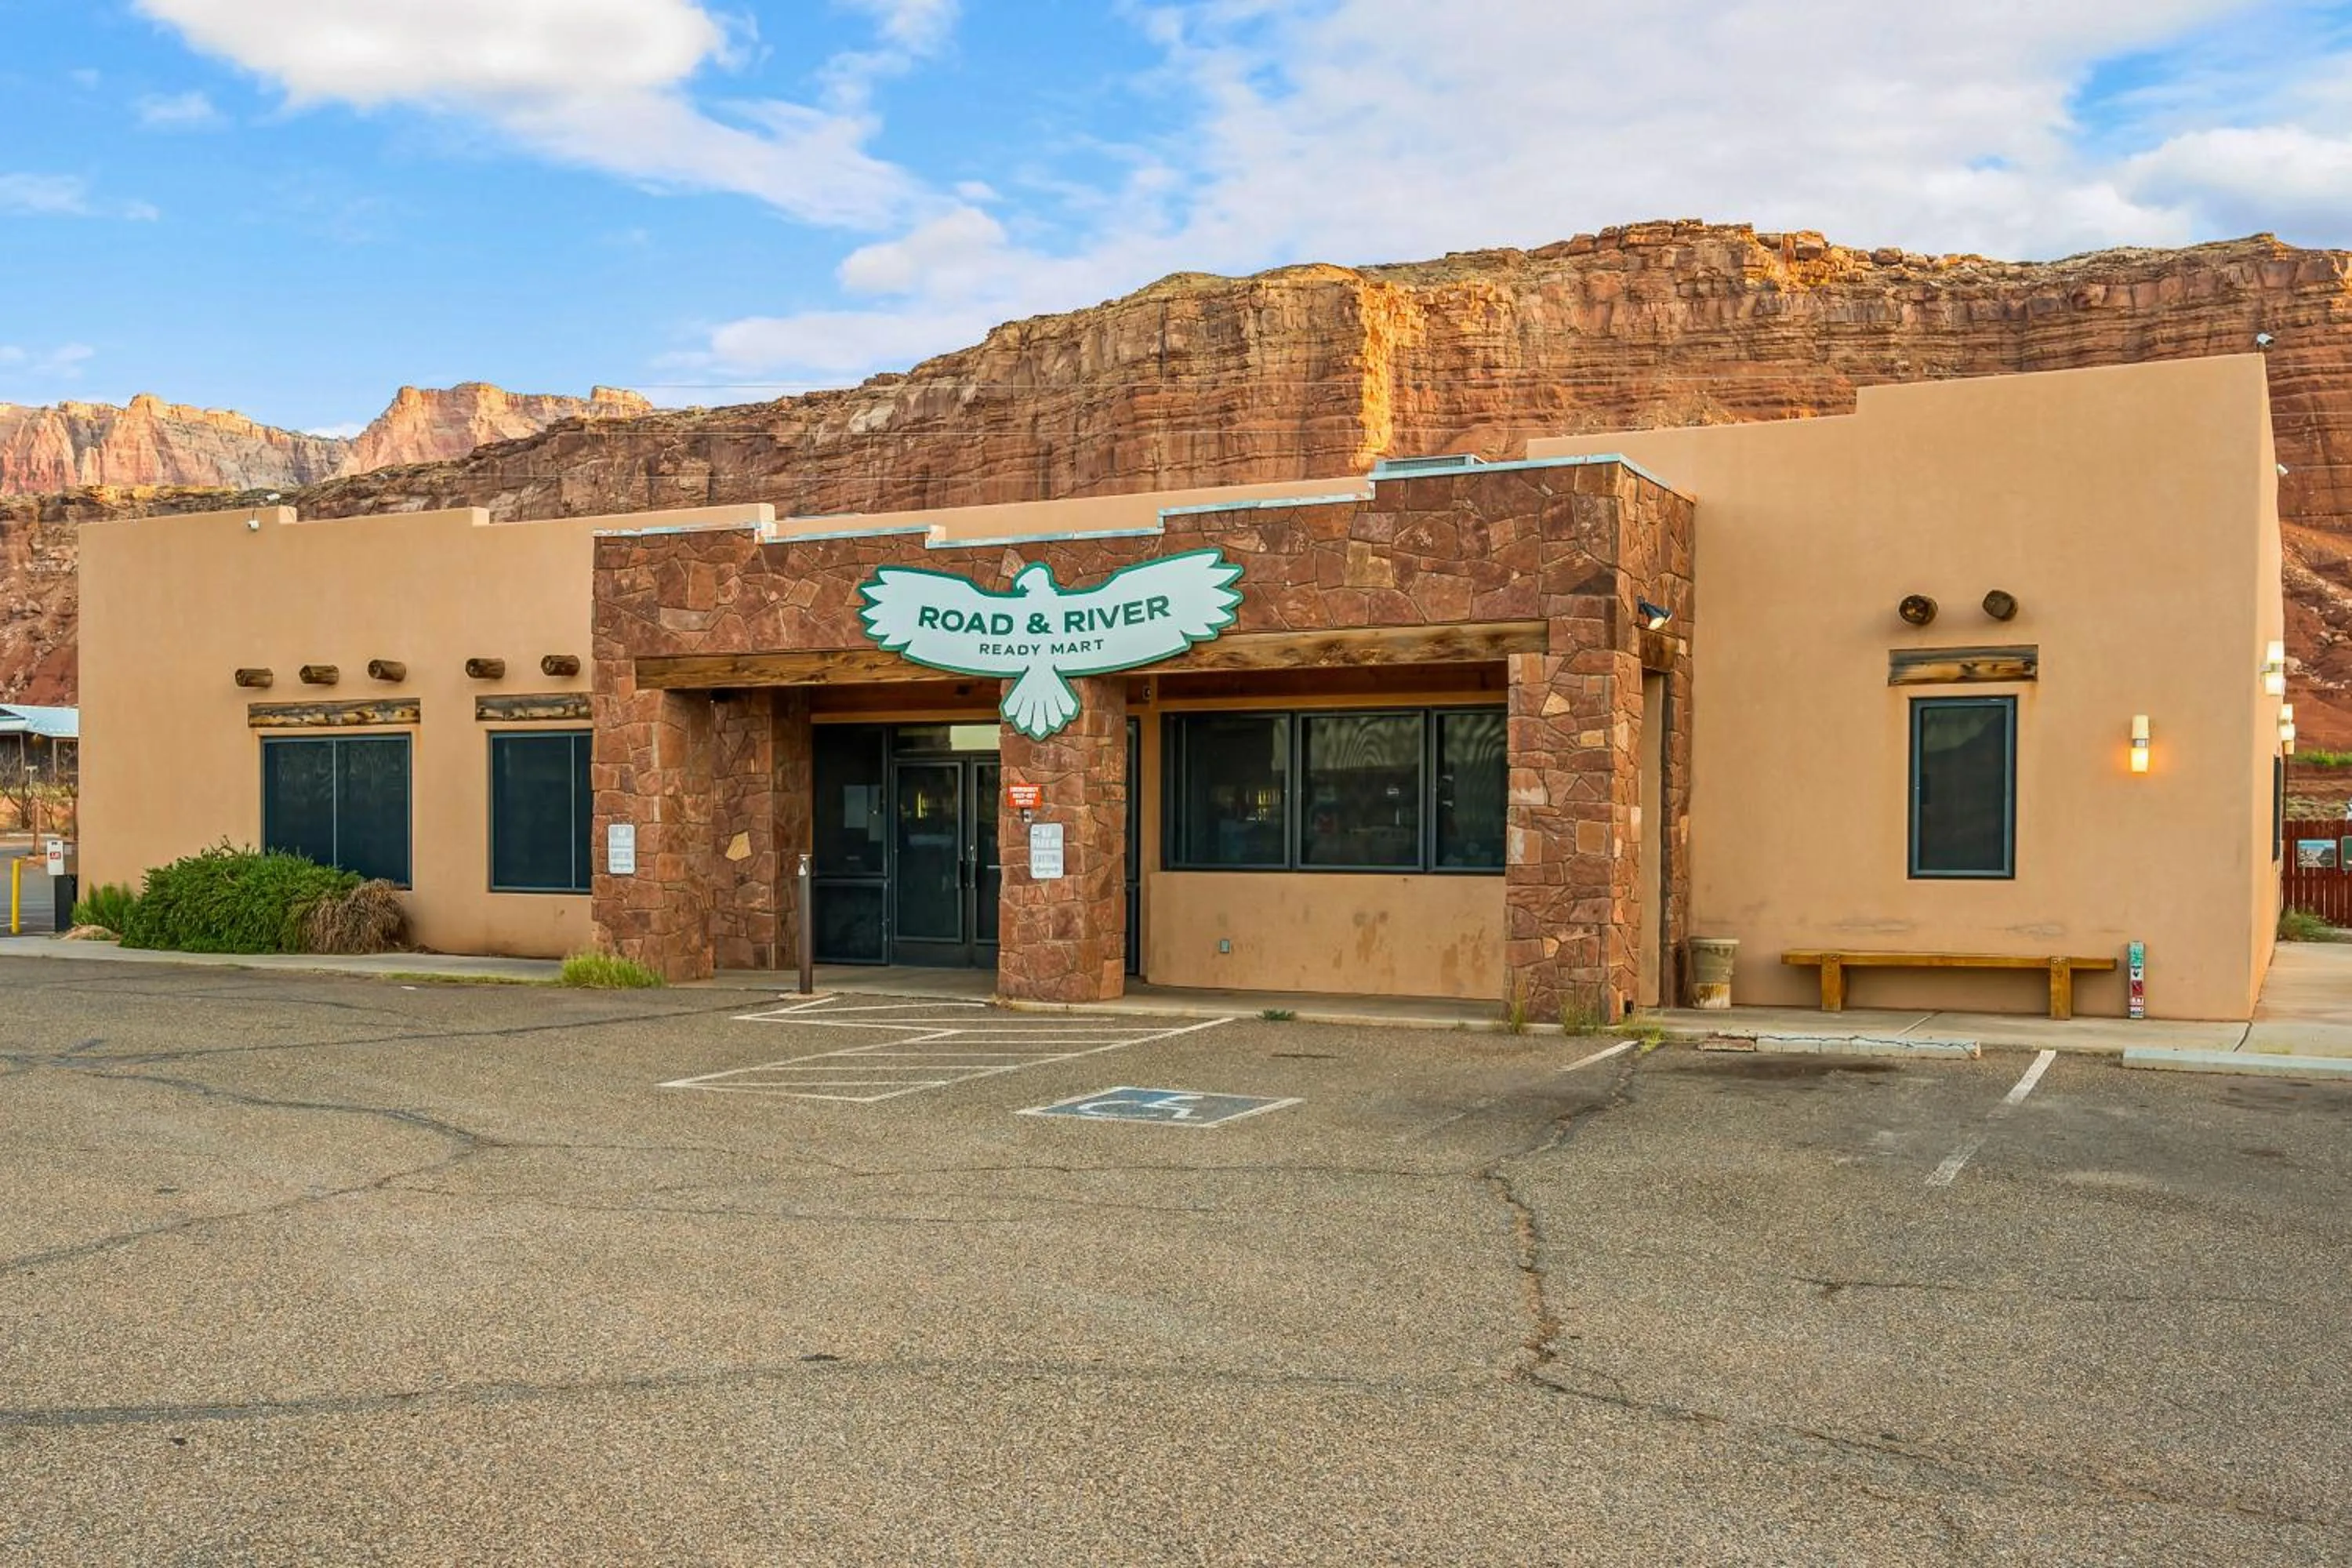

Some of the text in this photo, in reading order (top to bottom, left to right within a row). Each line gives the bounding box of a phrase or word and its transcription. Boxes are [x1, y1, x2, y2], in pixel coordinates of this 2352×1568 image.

[918, 595, 1171, 635] ROAD & RIVER
[979, 639, 1105, 655] READY MART
